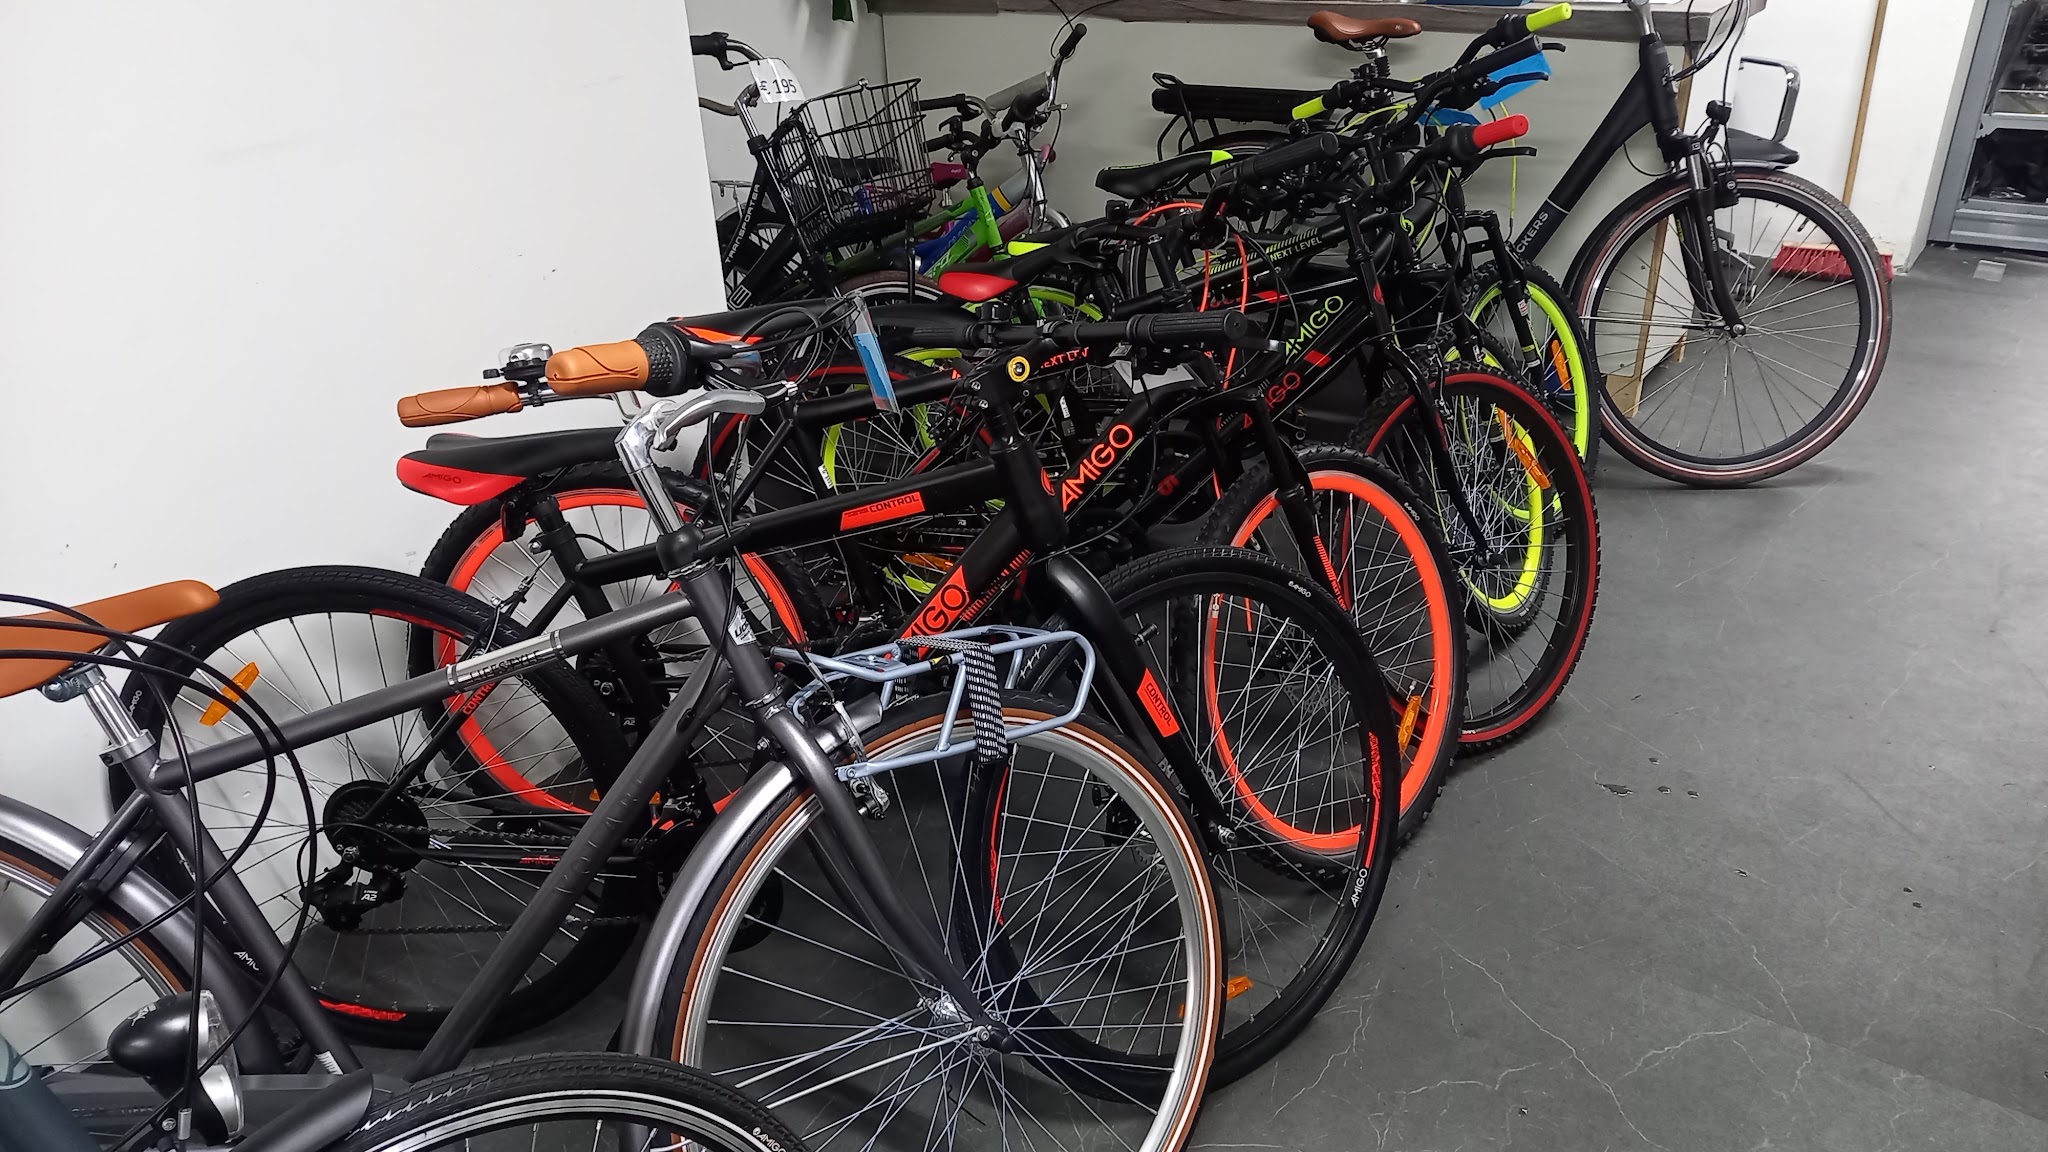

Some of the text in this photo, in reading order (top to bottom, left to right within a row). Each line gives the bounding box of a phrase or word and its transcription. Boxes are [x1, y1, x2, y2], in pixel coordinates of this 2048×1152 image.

[773, 79, 796, 93] 195
[725, 184, 760, 263] TRANSPORTER
[1516, 211, 1549, 253] CKERS
[1269, 236, 1322, 262] NEXT LEVEL
[1285, 295, 1344, 364] AMIGO
[1040, 354, 1065, 369] EXT
[422, 472, 462, 484] AMIGO
[1062, 424, 1134, 513] AMIGO
[869, 494, 920, 514] CONTROL
[910, 583, 967, 637] IGO
[462, 682, 496, 715] CONTR
[1145, 682, 1172, 728] CONTROL
[360, 893, 378, 902] A2
[1351, 868, 1368, 909] AMIGO
[233, 951, 260, 971] AMI
